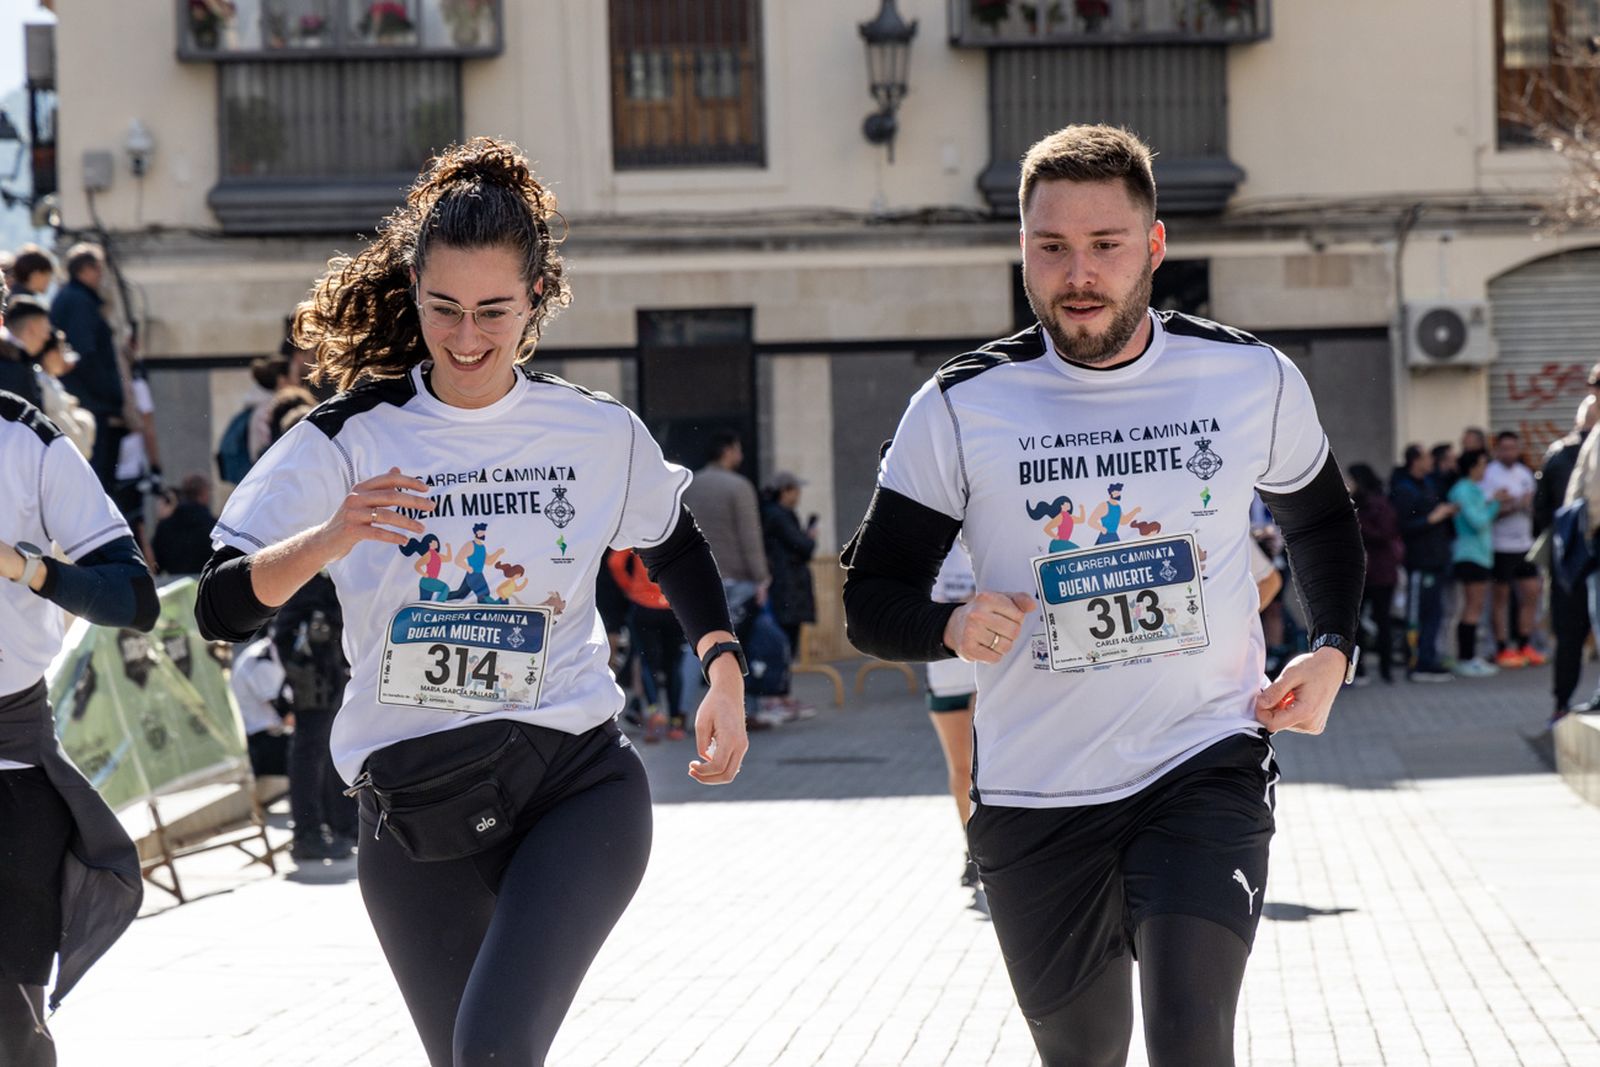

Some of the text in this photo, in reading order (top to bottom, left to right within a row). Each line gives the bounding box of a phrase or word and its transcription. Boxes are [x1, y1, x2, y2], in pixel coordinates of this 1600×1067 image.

[1018, 417, 1221, 451] VI CARRERA CAMINATA
[415, 466, 577, 488] ARRERA CAMINATA
[1019, 446, 1183, 486] BUENA MUERTE
[461, 491, 542, 517] MUERTE
[1056, 546, 1175, 575] VI CARRERA CAMINATA
[1058, 566, 1155, 597] BUENA MUERTE
[411, 611, 529, 626] VI CARRERA CAMINATA
[1087, 589, 1165, 640] 313
[406, 625, 502, 645] BUENA MUERTE
[1095, 639, 1120, 648] CARLES
[424, 644, 500, 691] 314
[476, 817, 497, 832] alo
